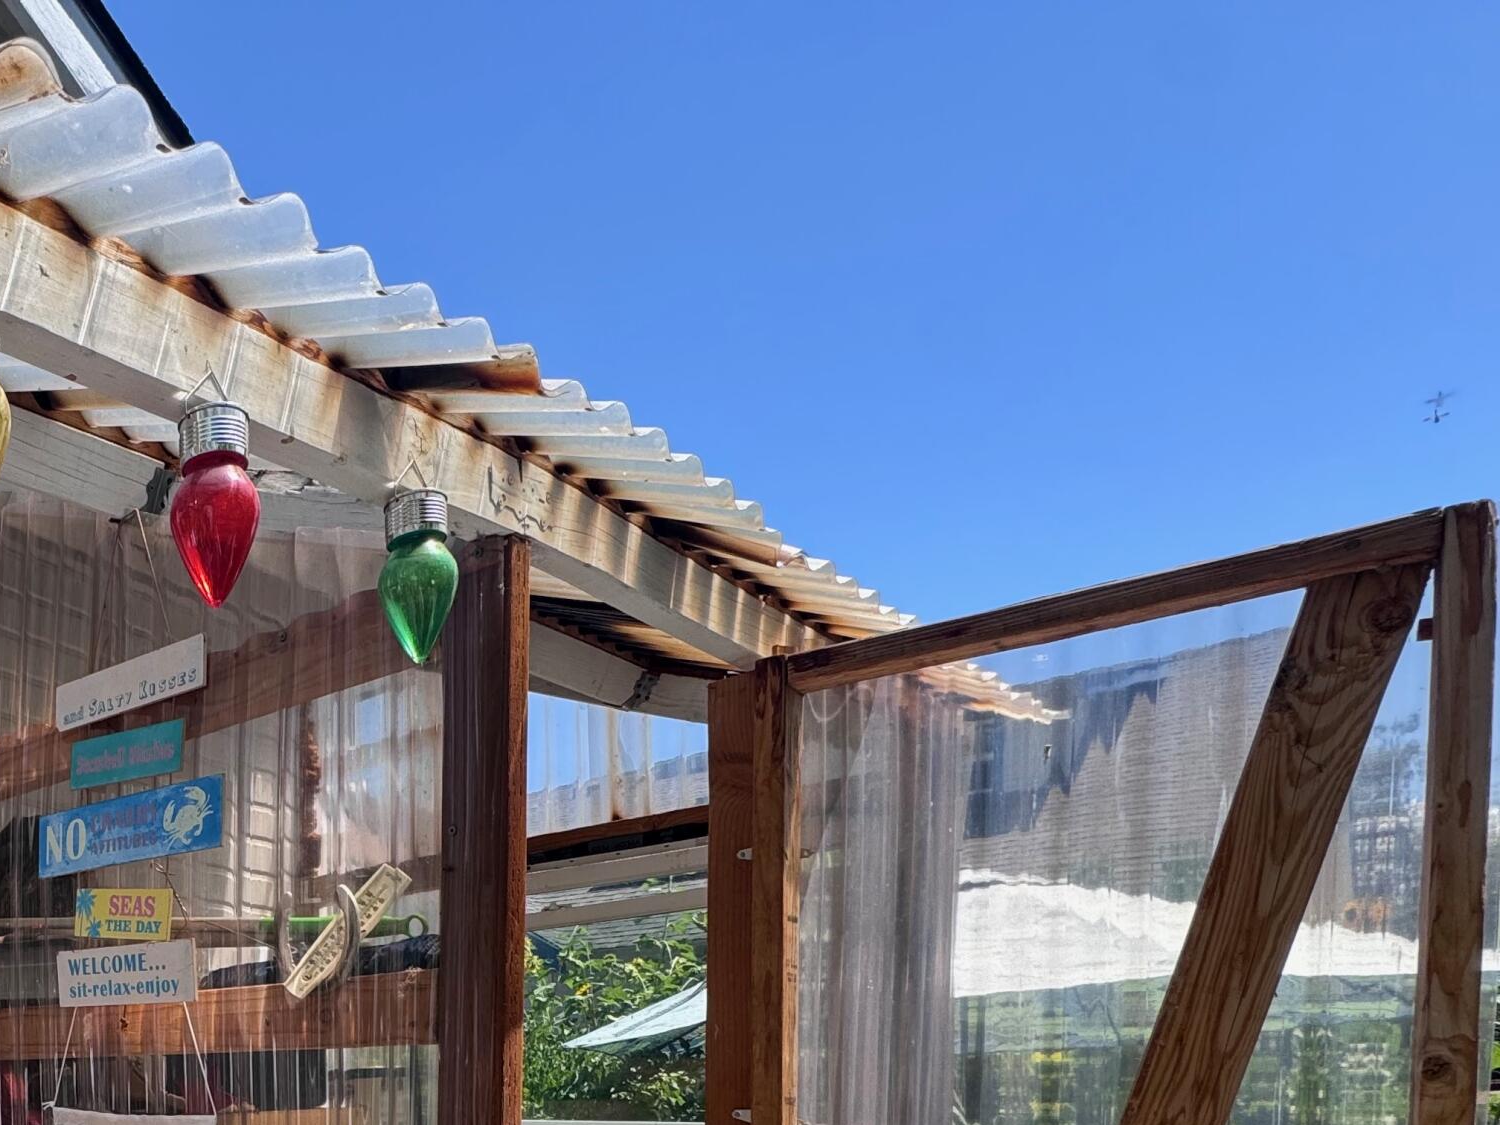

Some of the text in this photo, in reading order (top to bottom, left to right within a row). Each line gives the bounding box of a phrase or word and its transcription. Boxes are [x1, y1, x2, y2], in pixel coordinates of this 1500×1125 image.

[46, 818, 86, 866] NO
[108, 894, 156, 917] SEAS
[105, 919, 162, 934] THE DAY
[68, 953, 166, 976] WELCOME...
[69, 976, 180, 998] sit-relax-enjoy
